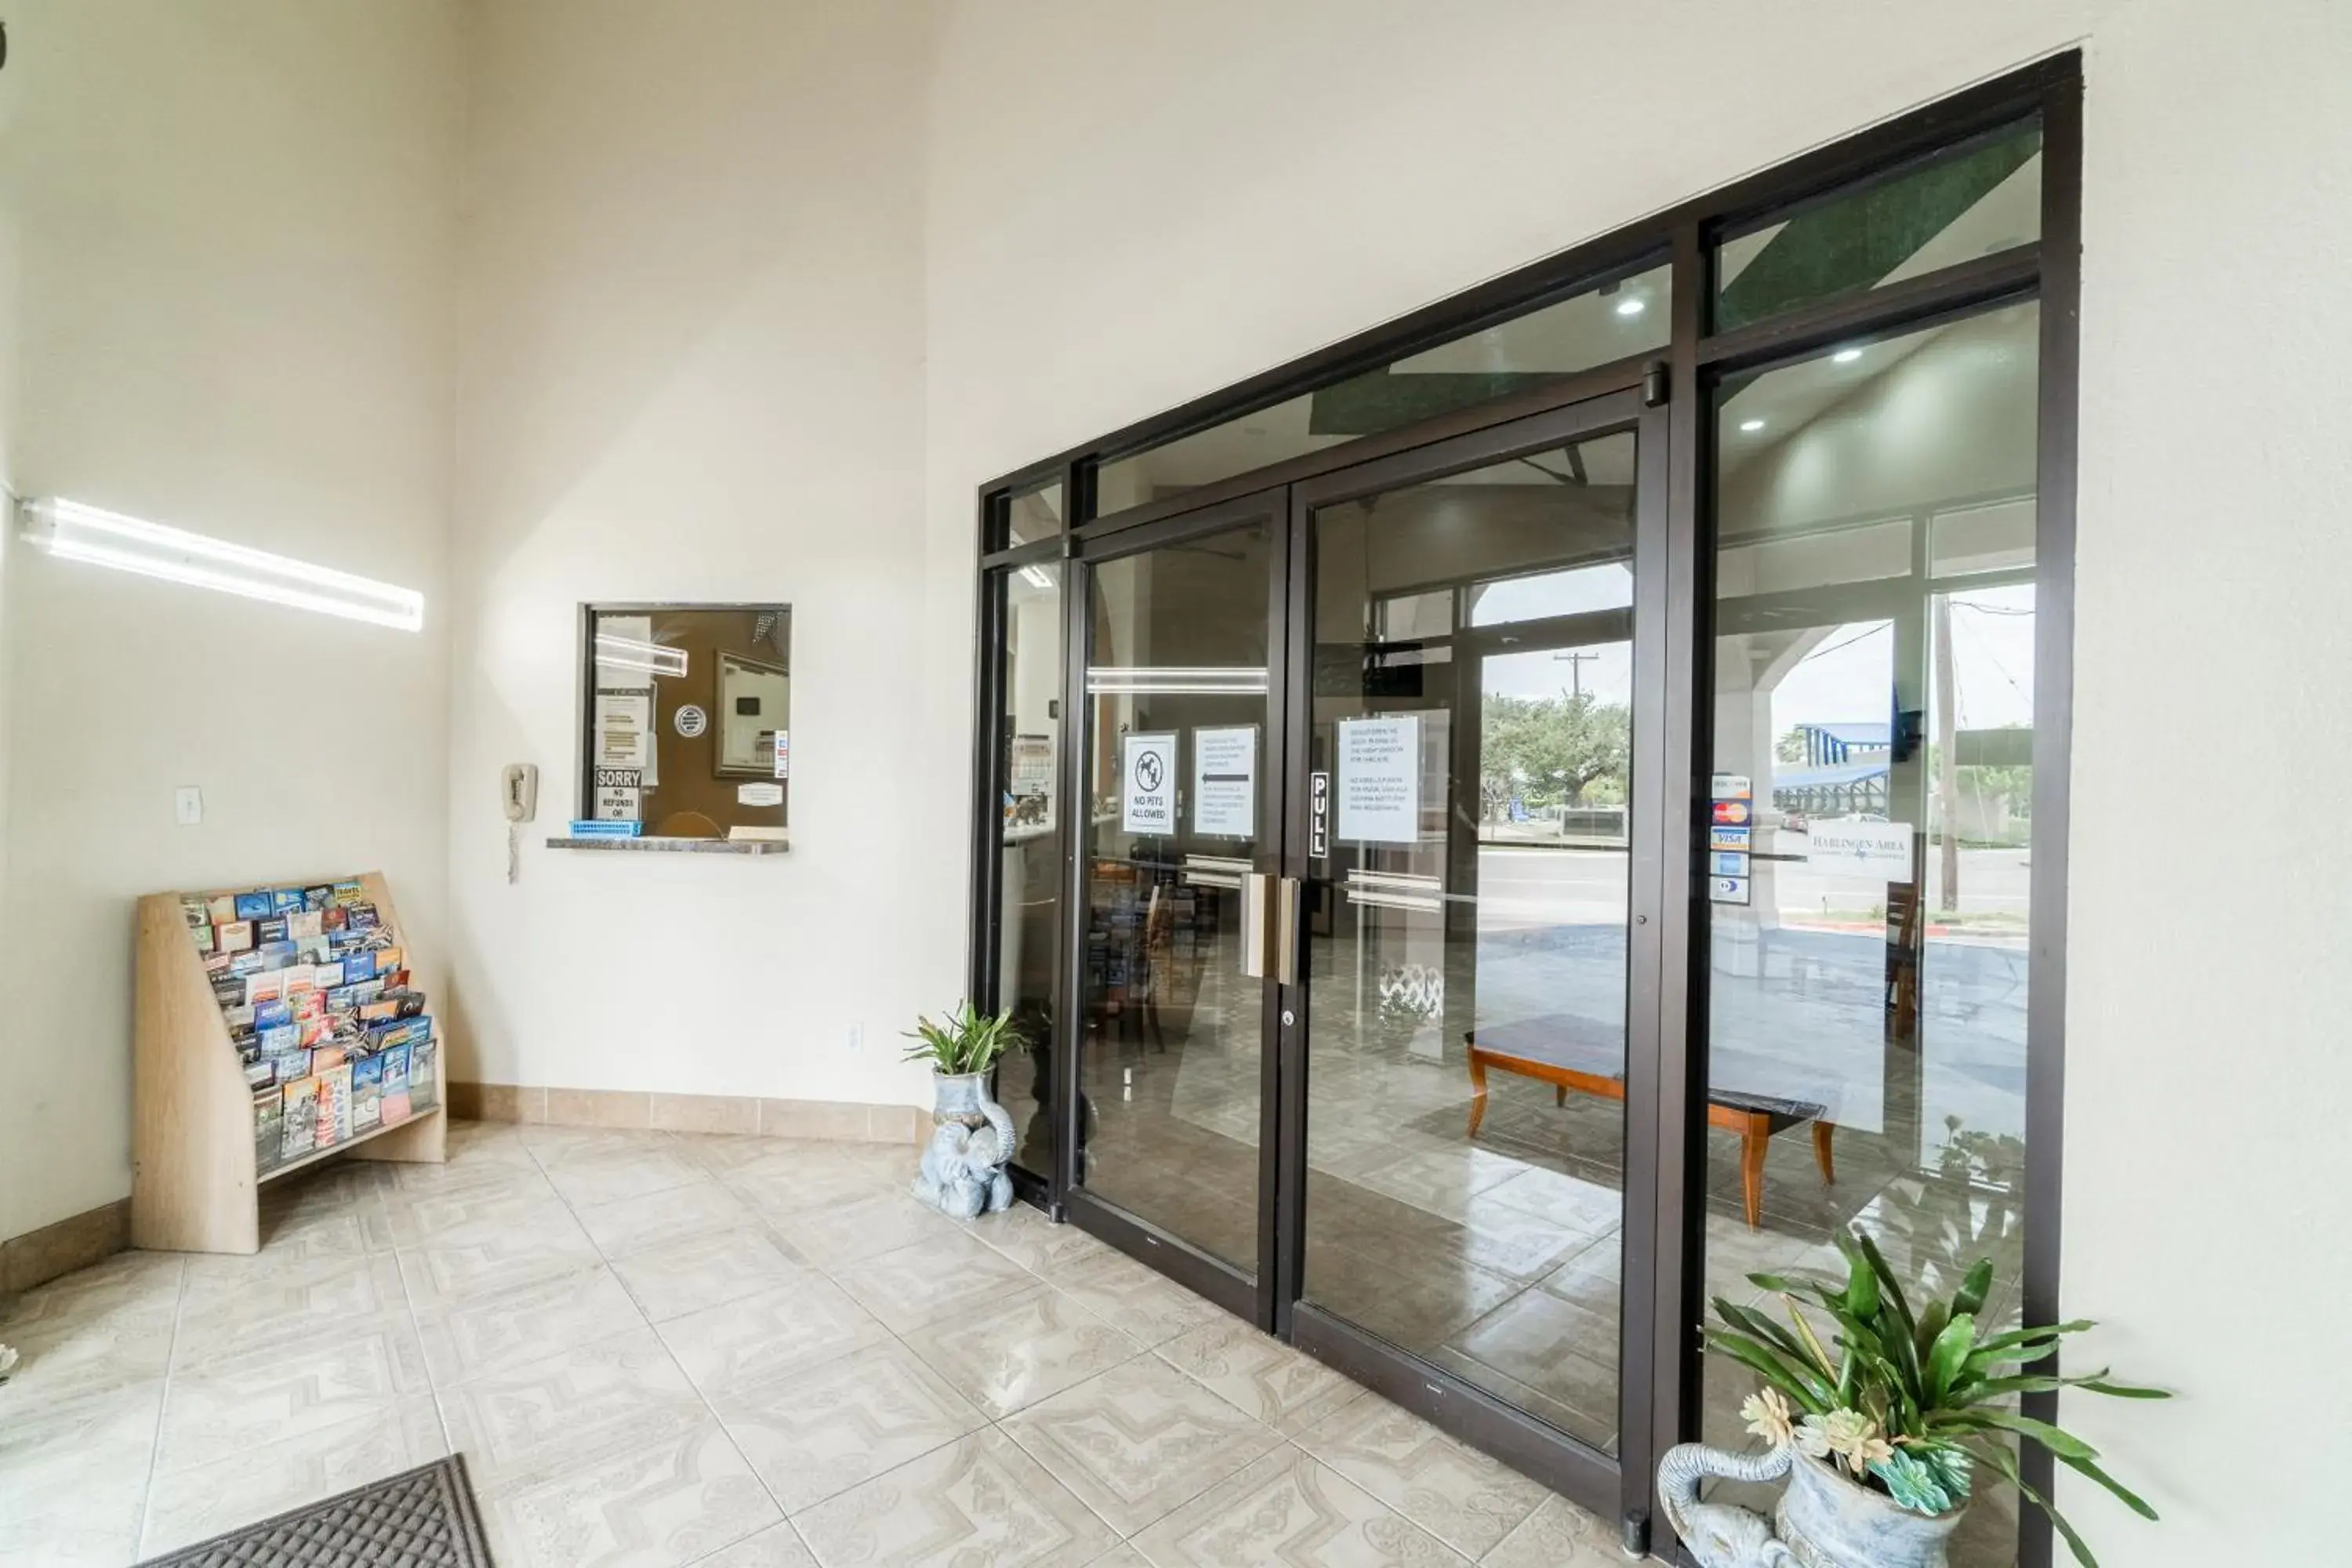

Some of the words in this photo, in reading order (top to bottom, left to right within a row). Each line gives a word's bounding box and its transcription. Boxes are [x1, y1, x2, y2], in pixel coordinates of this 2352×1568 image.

[598, 771, 641, 786] SORRY
[1134, 796, 1145, 805] NO
[1145, 796, 1163, 806] PETS
[1131, 808, 1167, 819] ALLOWED
[1315, 777, 1326, 852] PULL
[1718, 833, 1742, 844] VISA
